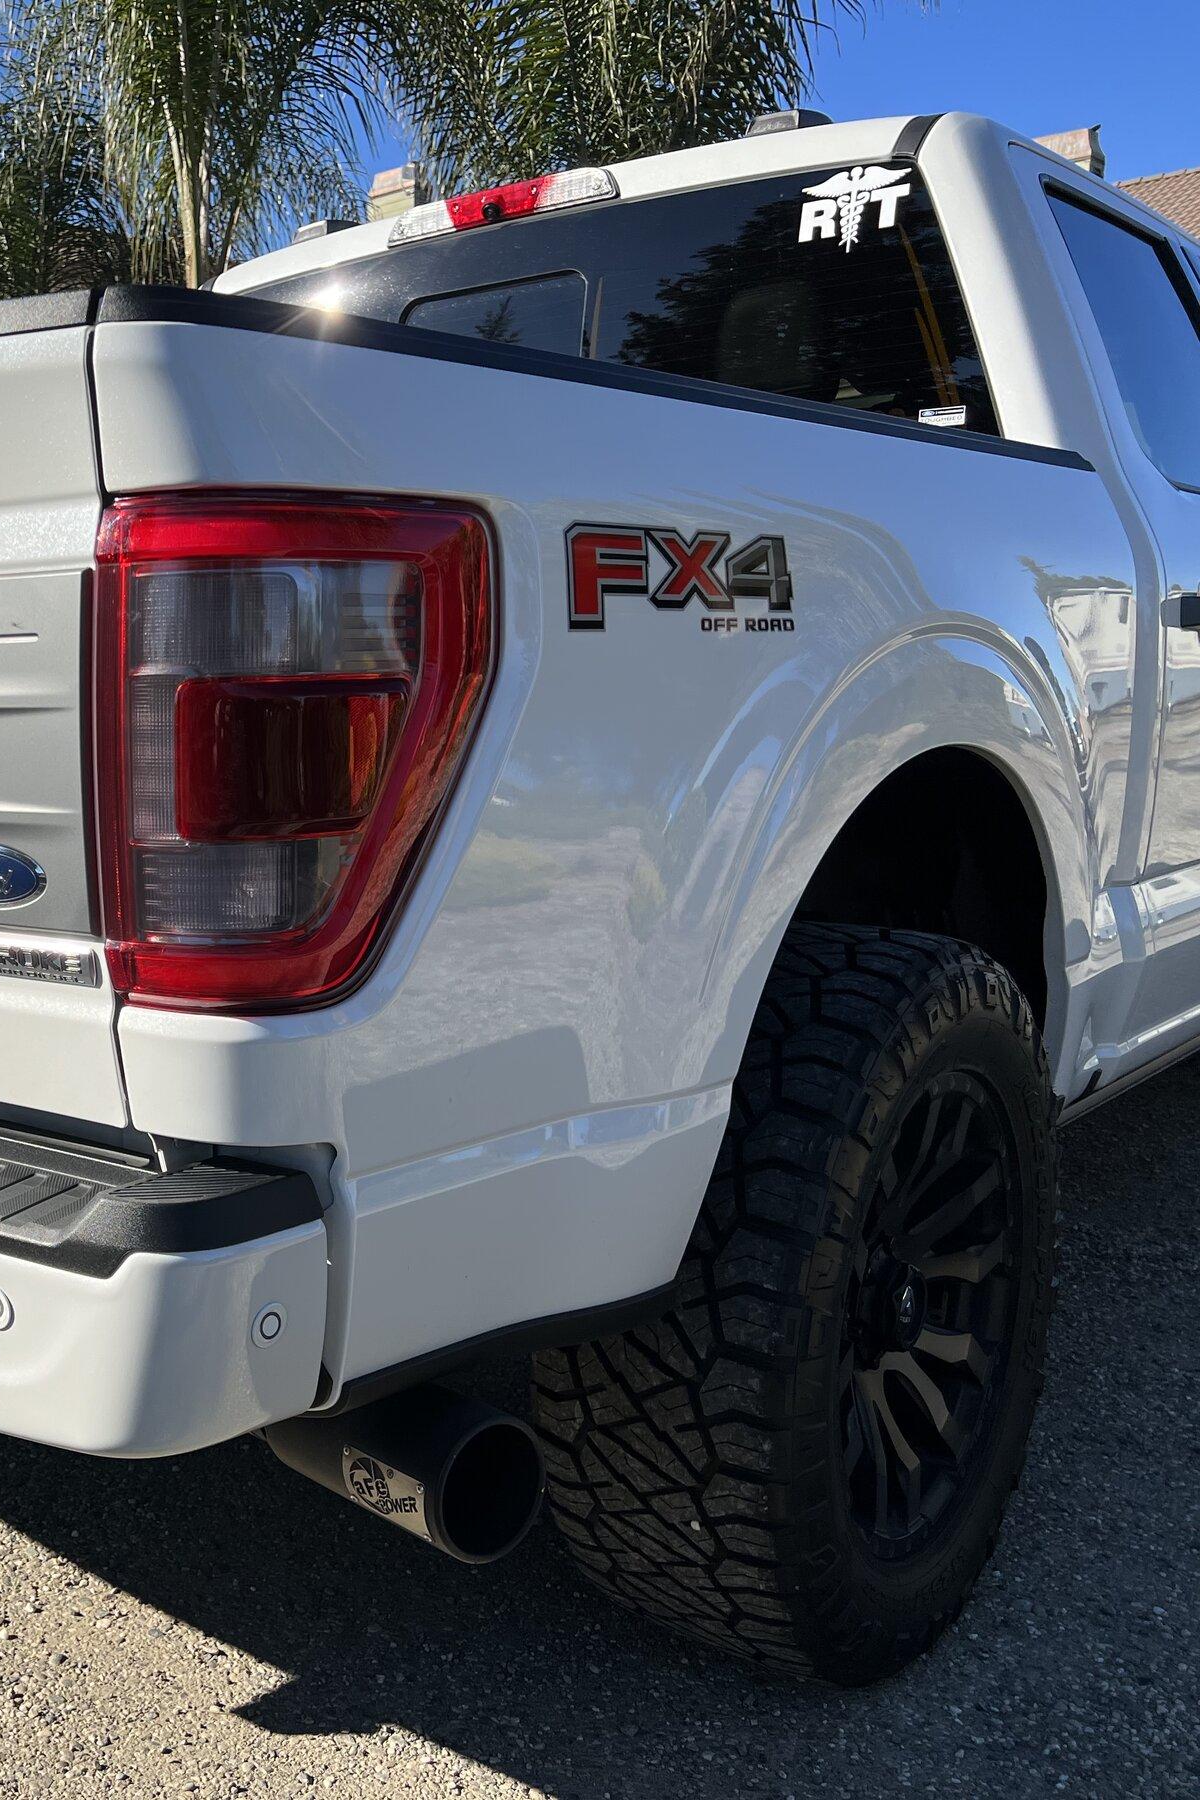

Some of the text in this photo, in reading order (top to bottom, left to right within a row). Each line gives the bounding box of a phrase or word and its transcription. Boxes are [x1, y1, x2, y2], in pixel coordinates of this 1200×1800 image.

[563, 519, 794, 632] FX4
[700, 617, 796, 632] OFF ROAD
[379, 1496, 418, 1514] POWER
